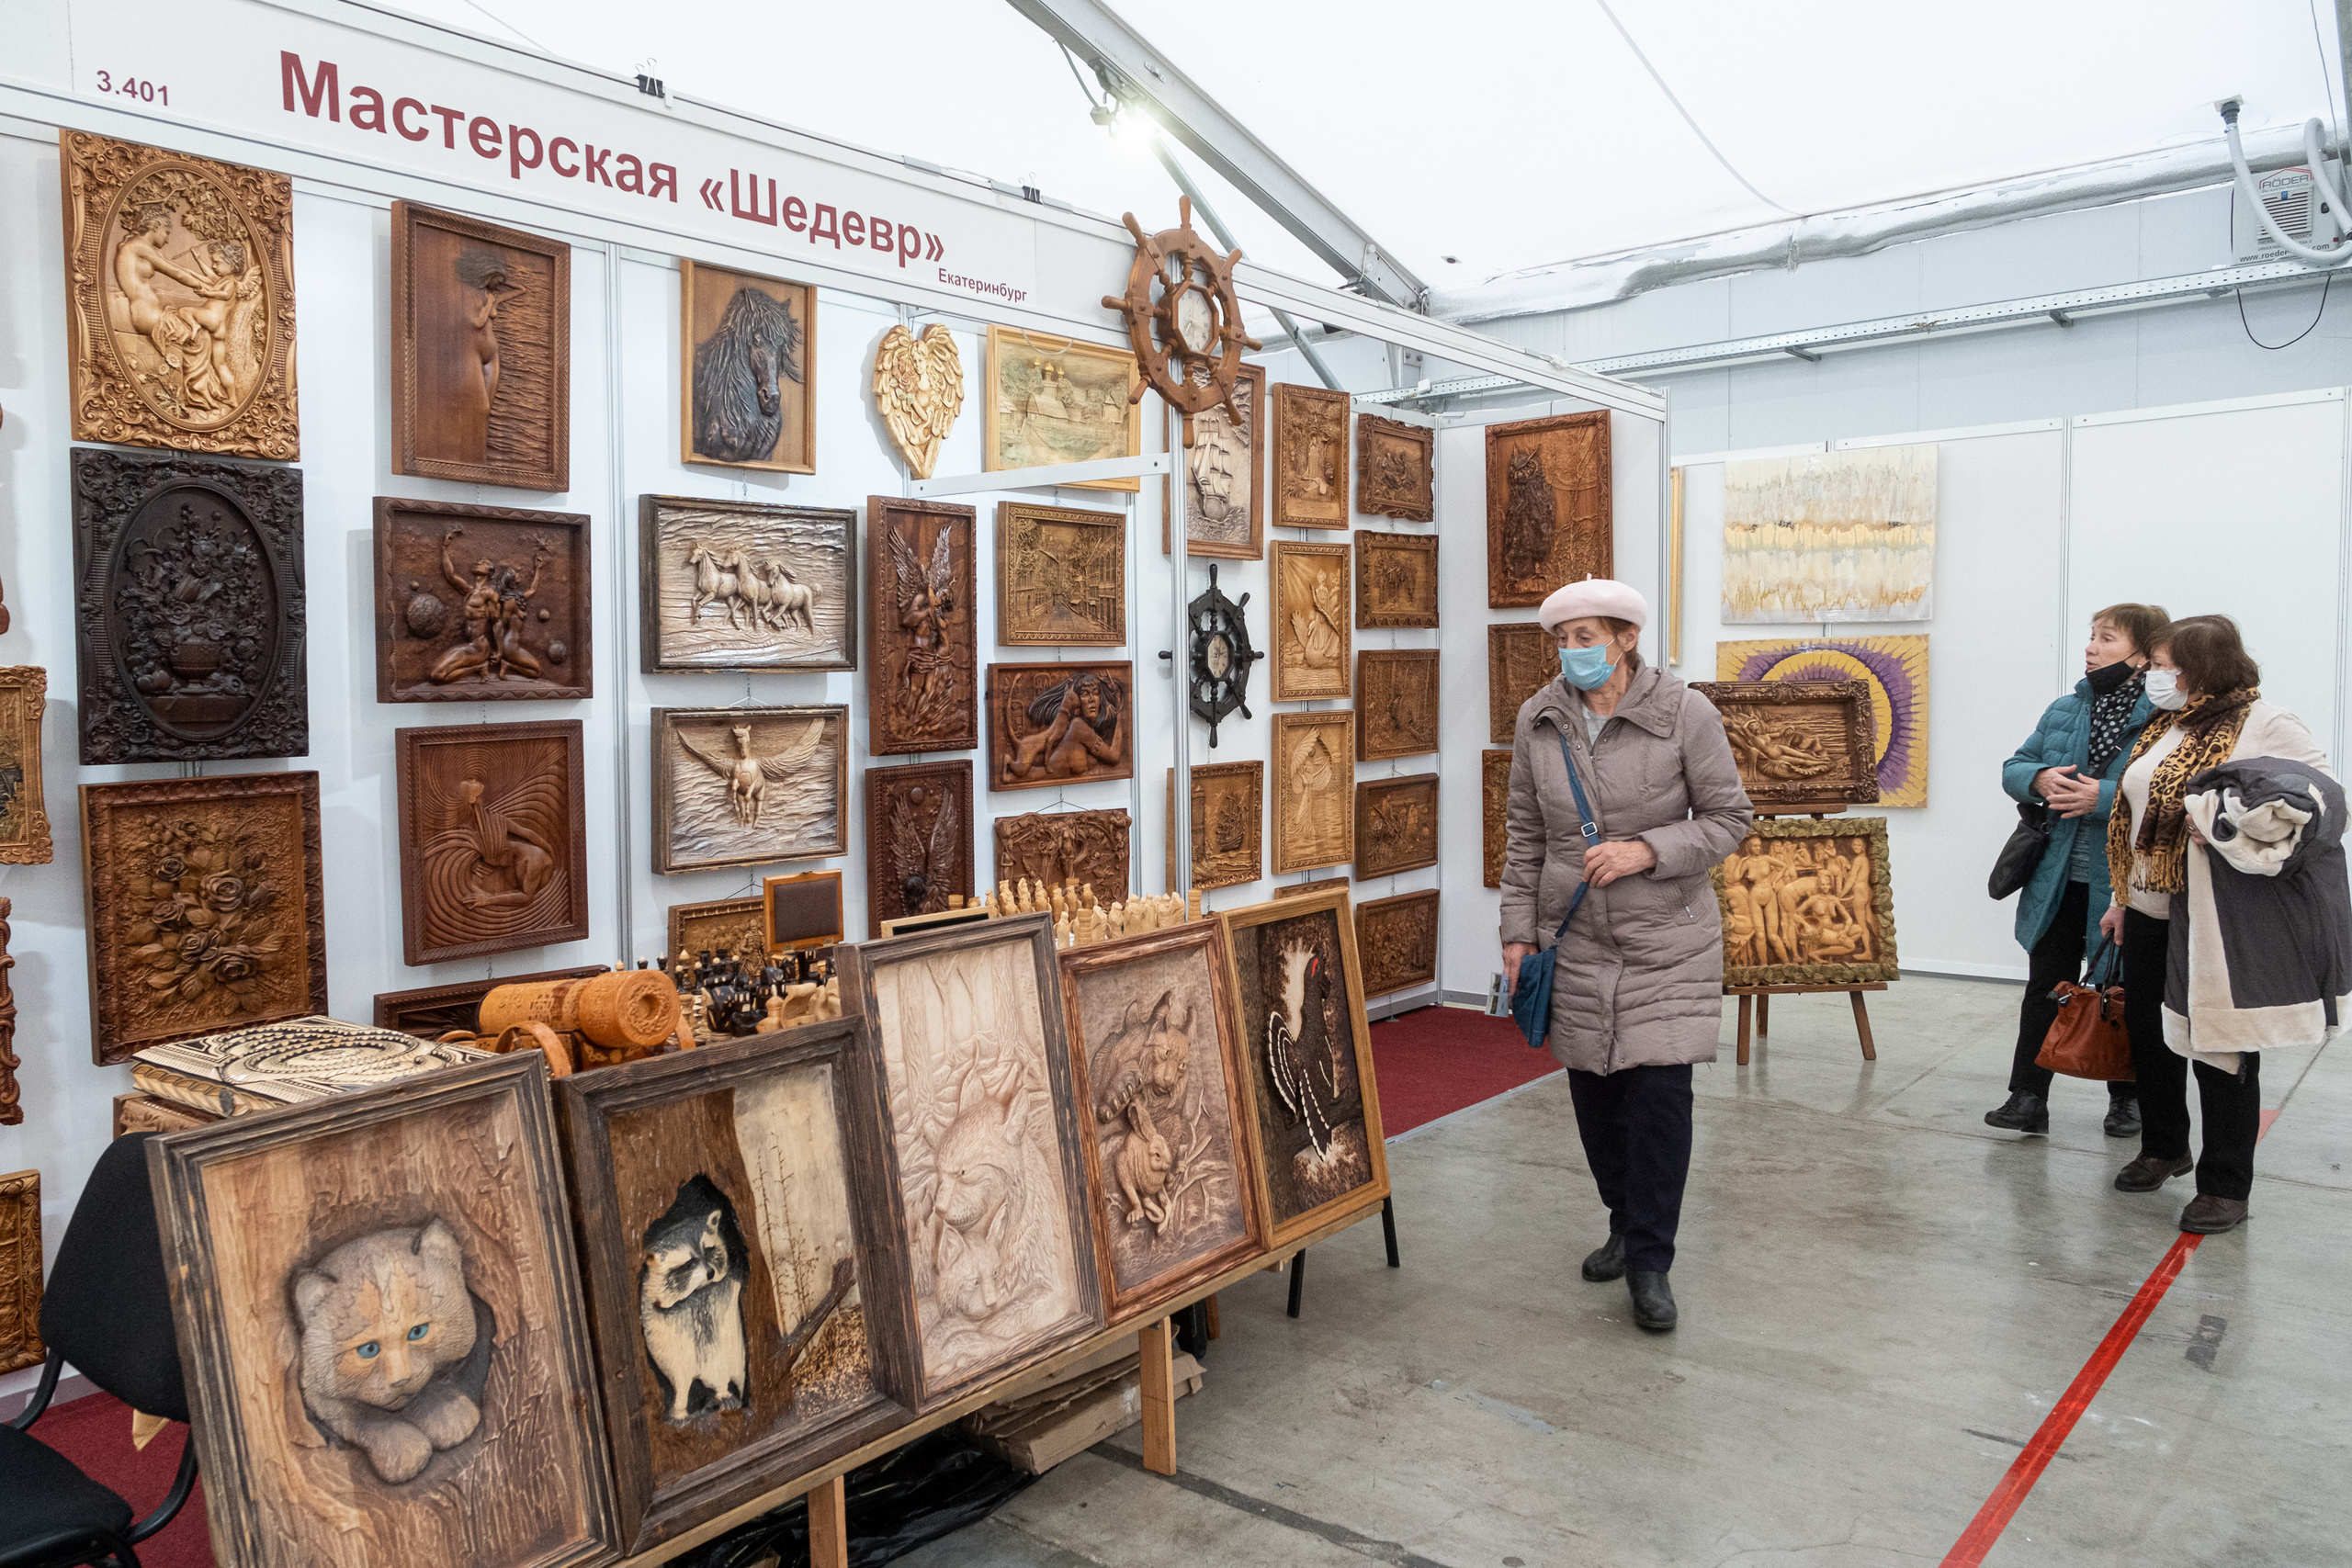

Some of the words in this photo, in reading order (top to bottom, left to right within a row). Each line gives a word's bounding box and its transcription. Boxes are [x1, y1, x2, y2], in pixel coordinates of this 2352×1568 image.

[96, 70, 169, 107] 3.401
[280, 50, 677, 204] Мастерская
[699, 168, 944, 269] «Шедевр»
[2262, 175, 2309, 189] RÖDER
[938, 267, 1027, 303] Екатеринбург
